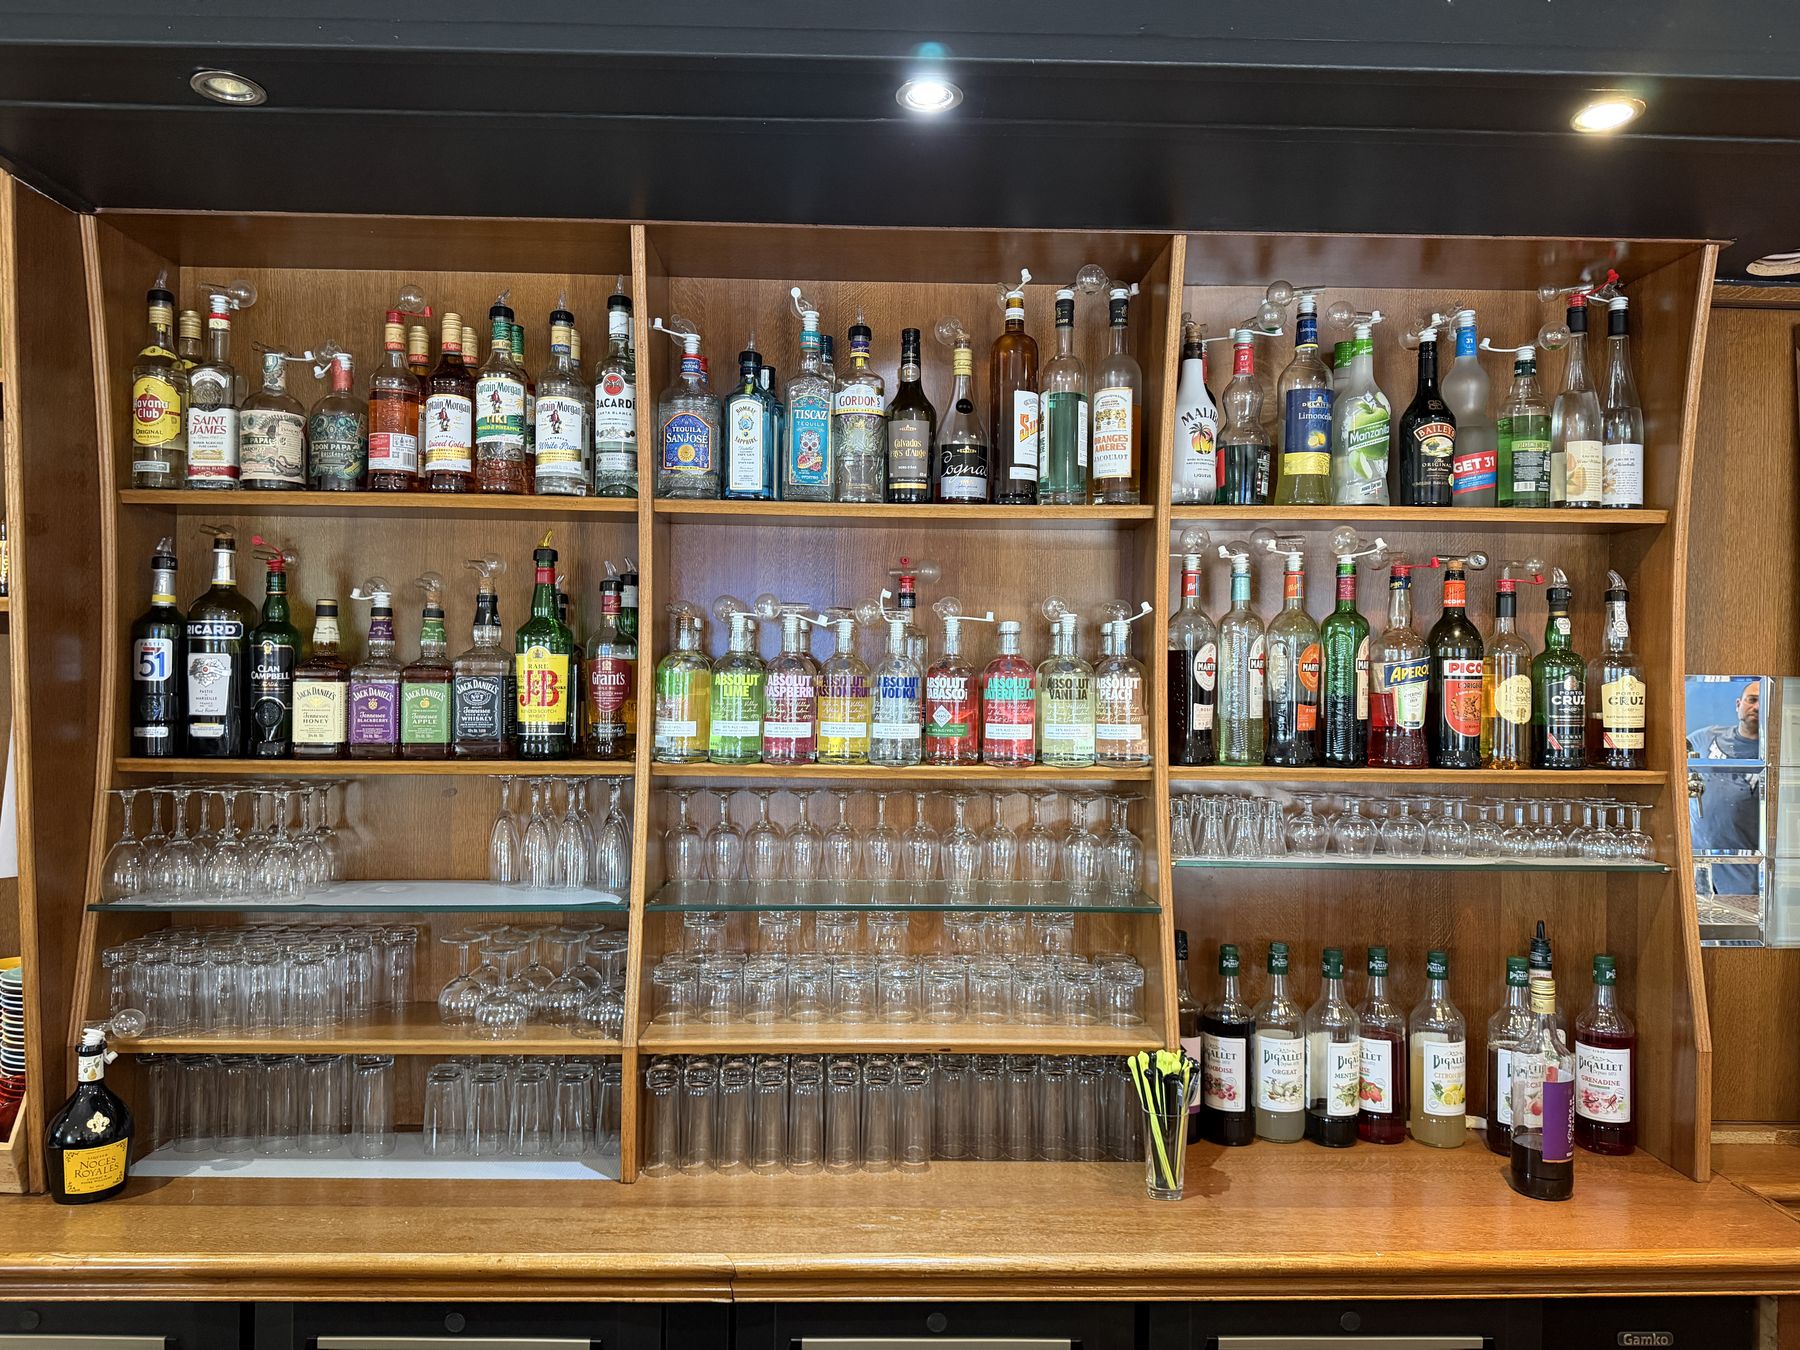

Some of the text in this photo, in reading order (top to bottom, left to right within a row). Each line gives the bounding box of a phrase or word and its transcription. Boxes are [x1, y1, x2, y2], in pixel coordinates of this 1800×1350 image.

[498, 382, 522, 396] Morgan
[445, 399, 470, 415] Morgan
[138, 409, 159, 419] Club
[193, 414, 226, 425] SAINT
[486, 414, 507, 425] TIKI
[794, 409, 828, 420] TISCAZ
[190, 425, 227, 435] JAMES
[1418, 423, 1456, 437] BAILEYS
[330, 443, 351, 451] PAPA
[448, 440, 466, 449] Gold
[1453, 455, 1494, 473] GET 31
[187, 624, 236, 635] RICARD
[139, 651, 165, 678] 51
[257, 664, 280, 673] CLAN
[1448, 662, 1483, 673] PICO
[251, 671, 290, 680] CAMPBELL
[591, 671, 626, 686] Grant's
[714, 673, 760, 686] ABSOLUT
[767, 673, 812, 687] ABSOLUT
[822, 675, 865, 687] ABSOLUT
[456, 679, 500, 695] JACK DANIEL'S
[519, 669, 560, 707] J&B
[878, 676, 920, 688] ABSOLUT
[927, 677, 968, 689] ABSOLUT
[987, 677, 1032, 689] ABSOLUT
[1047, 678, 1090, 689] ABSOLUT
[1096, 677, 1142, 689] ABSOLUT
[296, 686, 337, 701] JACK DANIEL'S
[352, 687, 394, 702] JACK DANIEL'S
[405, 687, 446, 702] JACK DANIEL'S
[723, 686, 750, 697] LIME
[881, 687, 916, 699] VODKA
[1099, 688, 1133, 700] PEACH
[1551, 695, 1586, 705] CRUZ
[1608, 696, 1644, 706] CRUZ
[1263, 1049, 1303, 1066] BIGALLET
[1579, 1055, 1624, 1074] BIGALLET
[1580, 1074, 1621, 1087] GRENADINE
[80, 1155, 117, 1170] NOCES
[74, 1162, 119, 1178] ROYALES
[1623, 1333, 1669, 1346] Gamko
